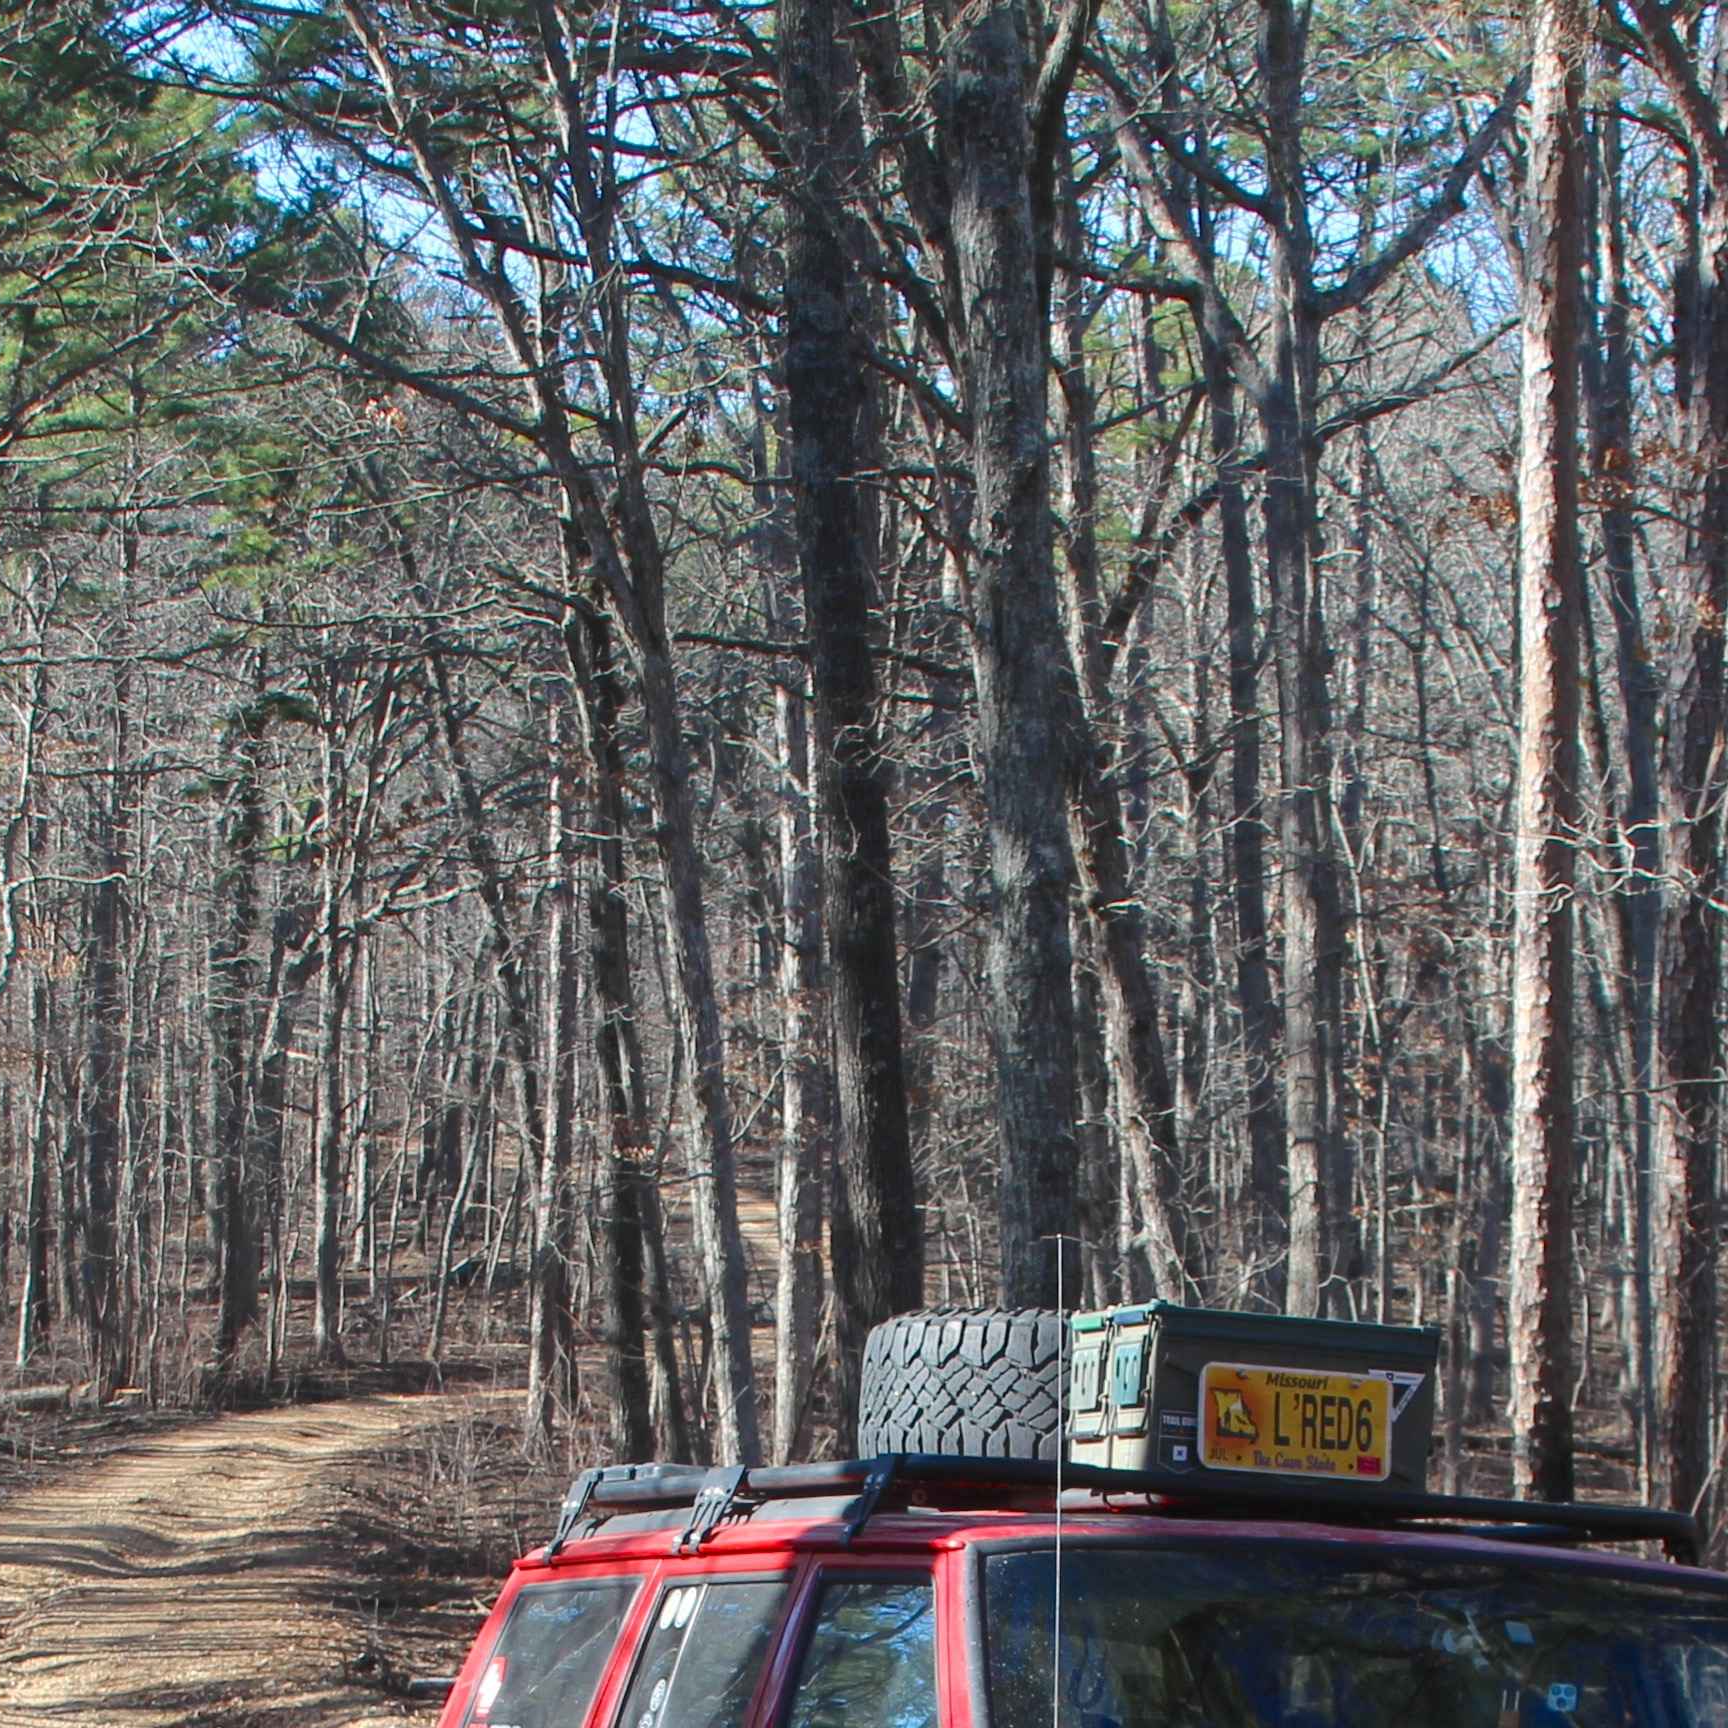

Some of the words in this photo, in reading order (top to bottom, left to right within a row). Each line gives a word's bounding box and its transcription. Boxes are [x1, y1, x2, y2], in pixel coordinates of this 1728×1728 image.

[1265, 1372, 1330, 1390] Missouri
[1273, 1391, 1373, 1452] L'RED6
[1253, 1450, 1272, 1466] The
[1306, 1453, 1337, 1473] State
